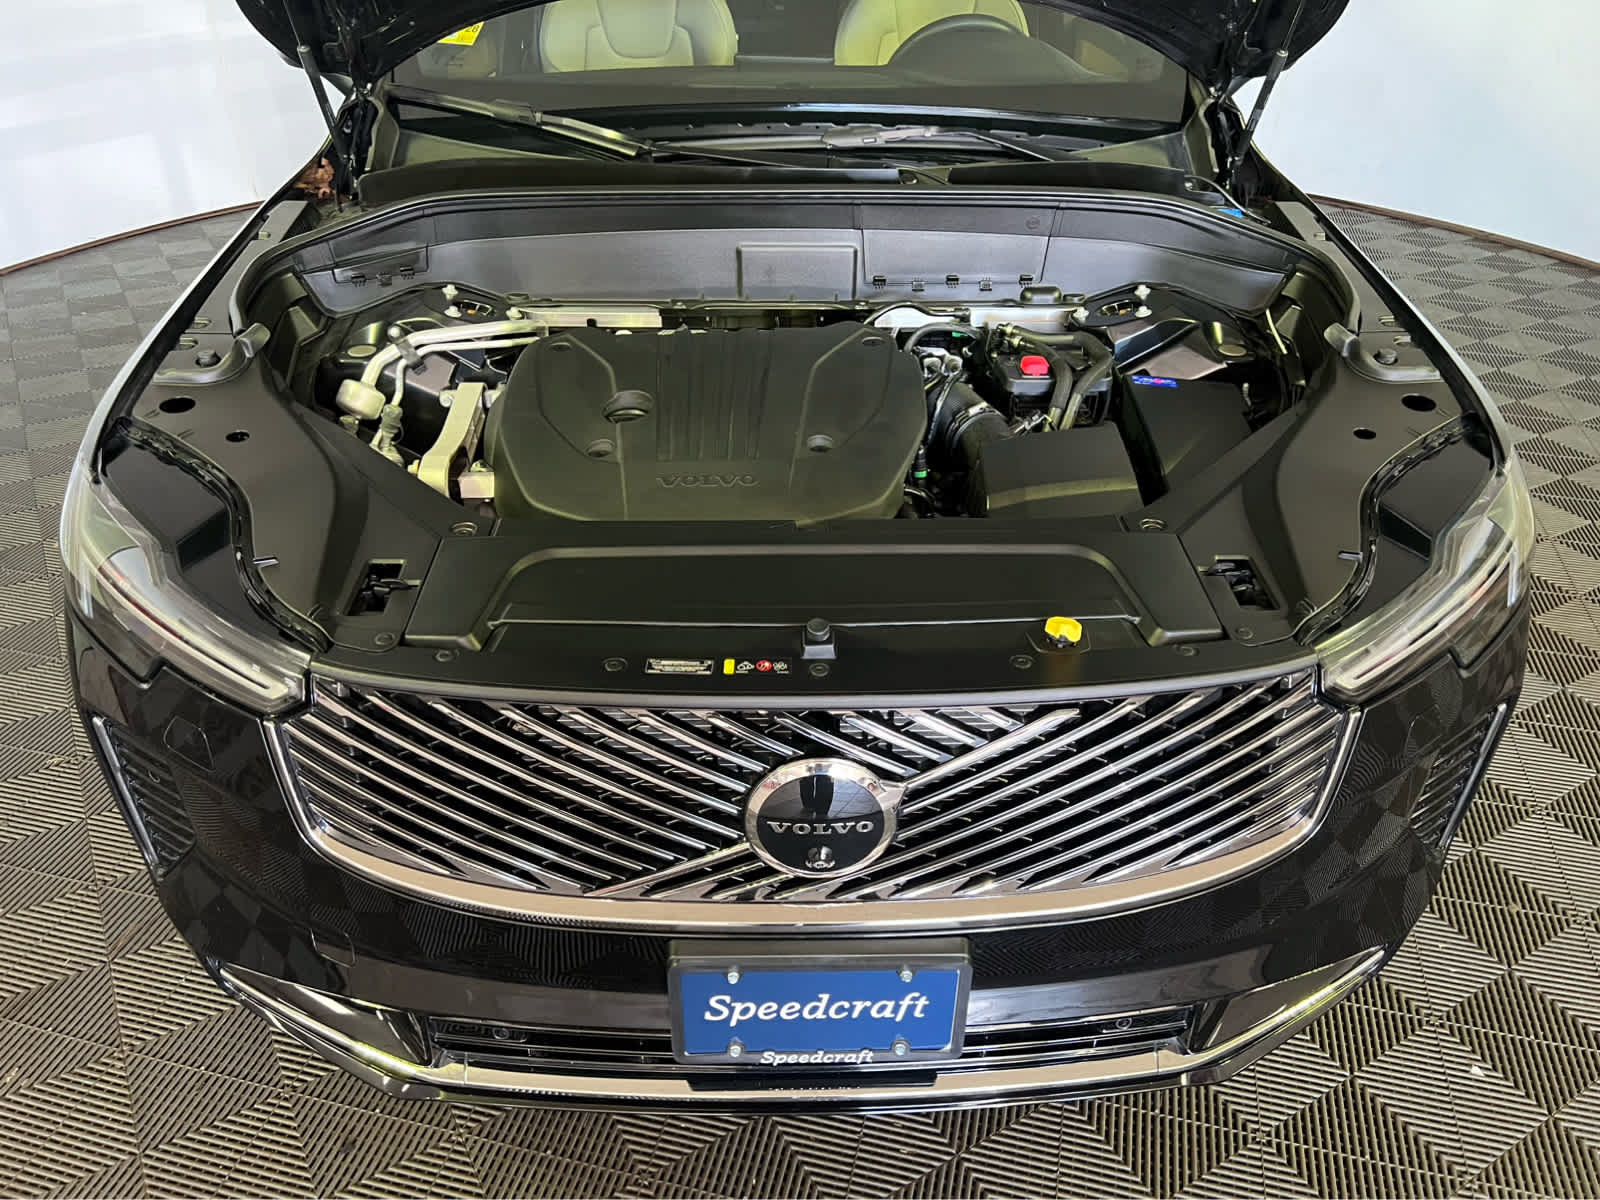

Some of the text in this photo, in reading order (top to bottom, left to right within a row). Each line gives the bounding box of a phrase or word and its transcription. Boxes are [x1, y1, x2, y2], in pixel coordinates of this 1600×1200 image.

[656, 473, 760, 488] VOLVO
[766, 821, 874, 835] VOLVO
[704, 992, 930, 1027] Speedcraft
[760, 1049, 873, 1066] Speedcraft
